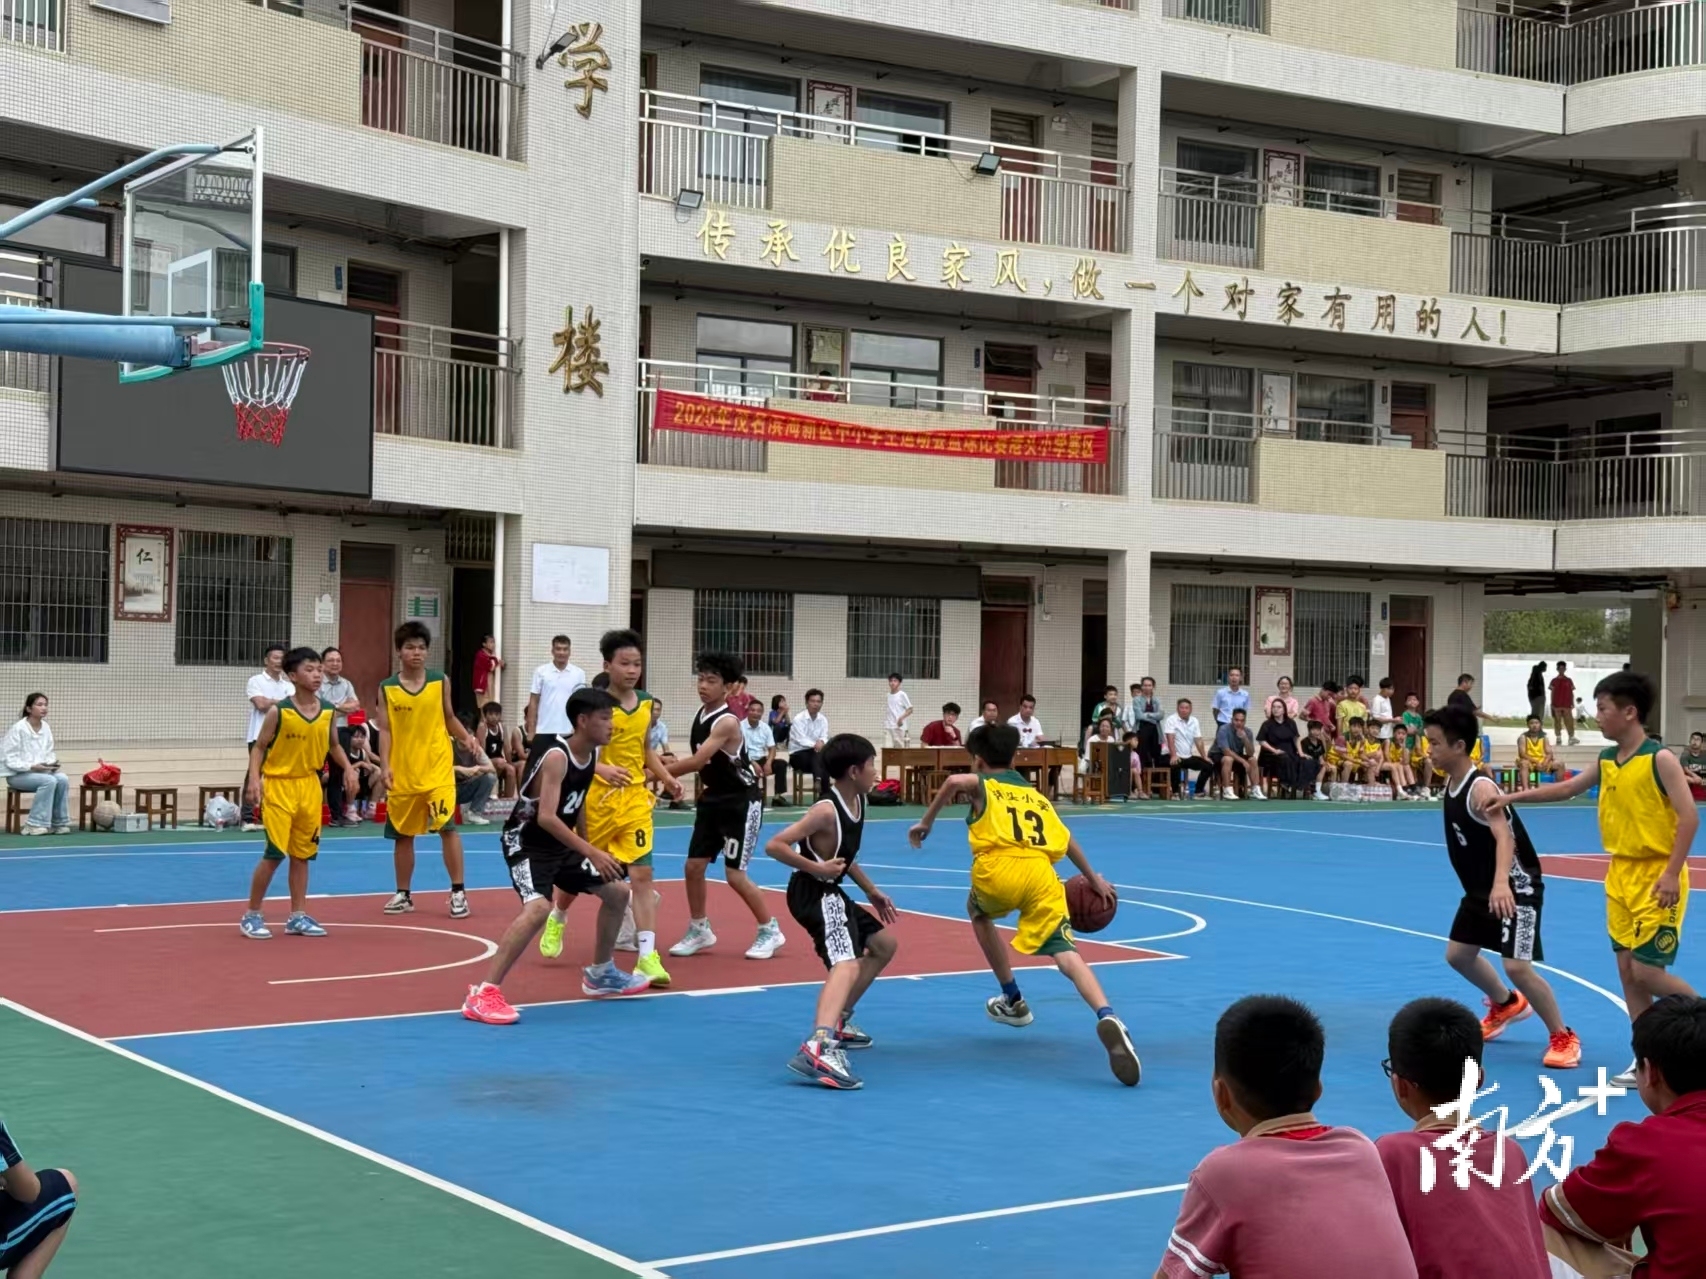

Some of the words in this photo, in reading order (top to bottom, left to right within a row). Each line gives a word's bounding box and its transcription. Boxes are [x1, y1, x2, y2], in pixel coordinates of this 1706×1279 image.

[136, 547, 153, 565] 仁
[431, 799, 448, 818] 14
[1006, 806, 1047, 846] 13
[310, 827, 320, 845] 4
[635, 829, 646, 848] 8
